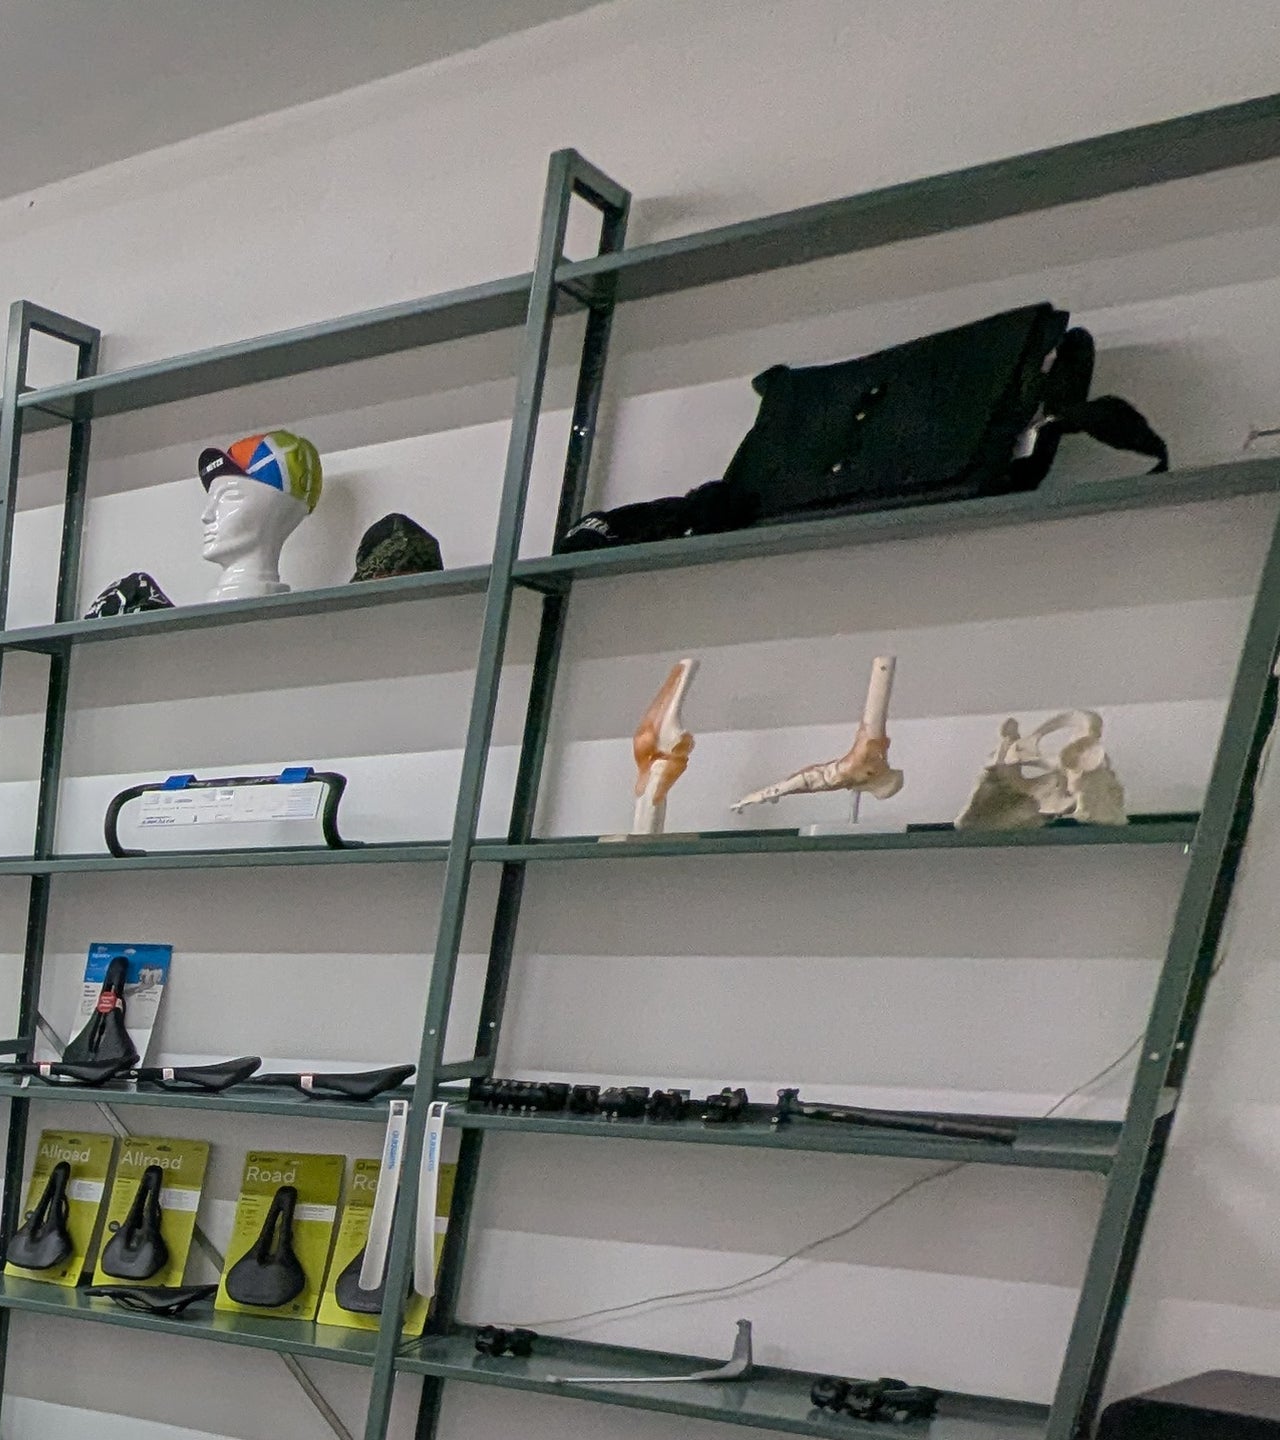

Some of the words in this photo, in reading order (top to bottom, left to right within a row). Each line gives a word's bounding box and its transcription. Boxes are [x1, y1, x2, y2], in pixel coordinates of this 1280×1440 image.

[40, 1144, 90, 1163] Allroad
[121, 1150, 183, 1170] Allroad
[246, 1166, 296, 1184] Road
[352, 1173, 378, 1191] Ro
